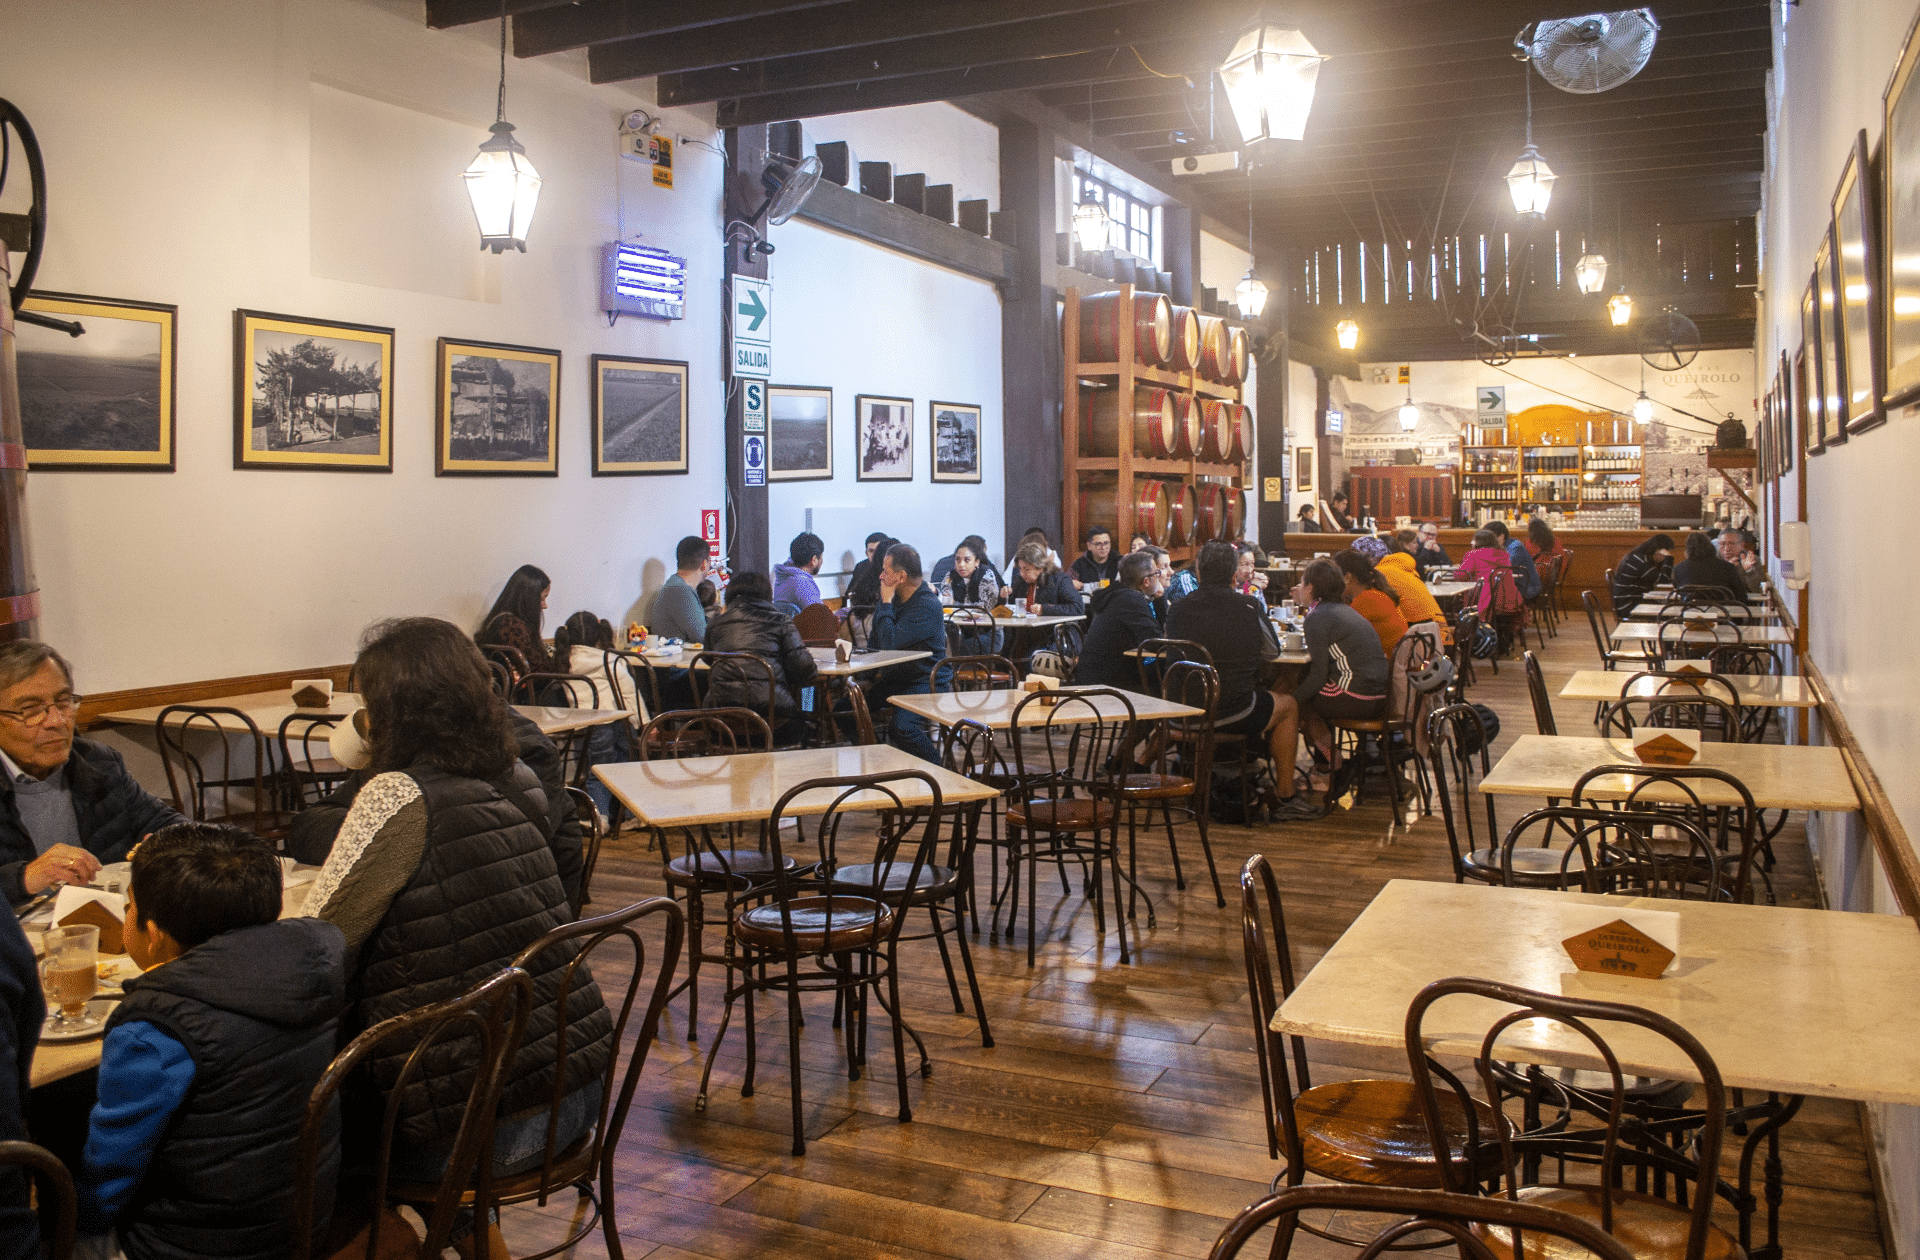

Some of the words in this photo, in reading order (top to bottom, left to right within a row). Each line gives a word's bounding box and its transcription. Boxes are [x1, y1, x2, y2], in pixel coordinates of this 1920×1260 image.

[737, 349, 768, 368] SALIDA
[1662, 373, 1740, 387] QUEIROLO
[747, 385, 761, 410] S
[1588, 939, 1650, 953] QUEIROLO
